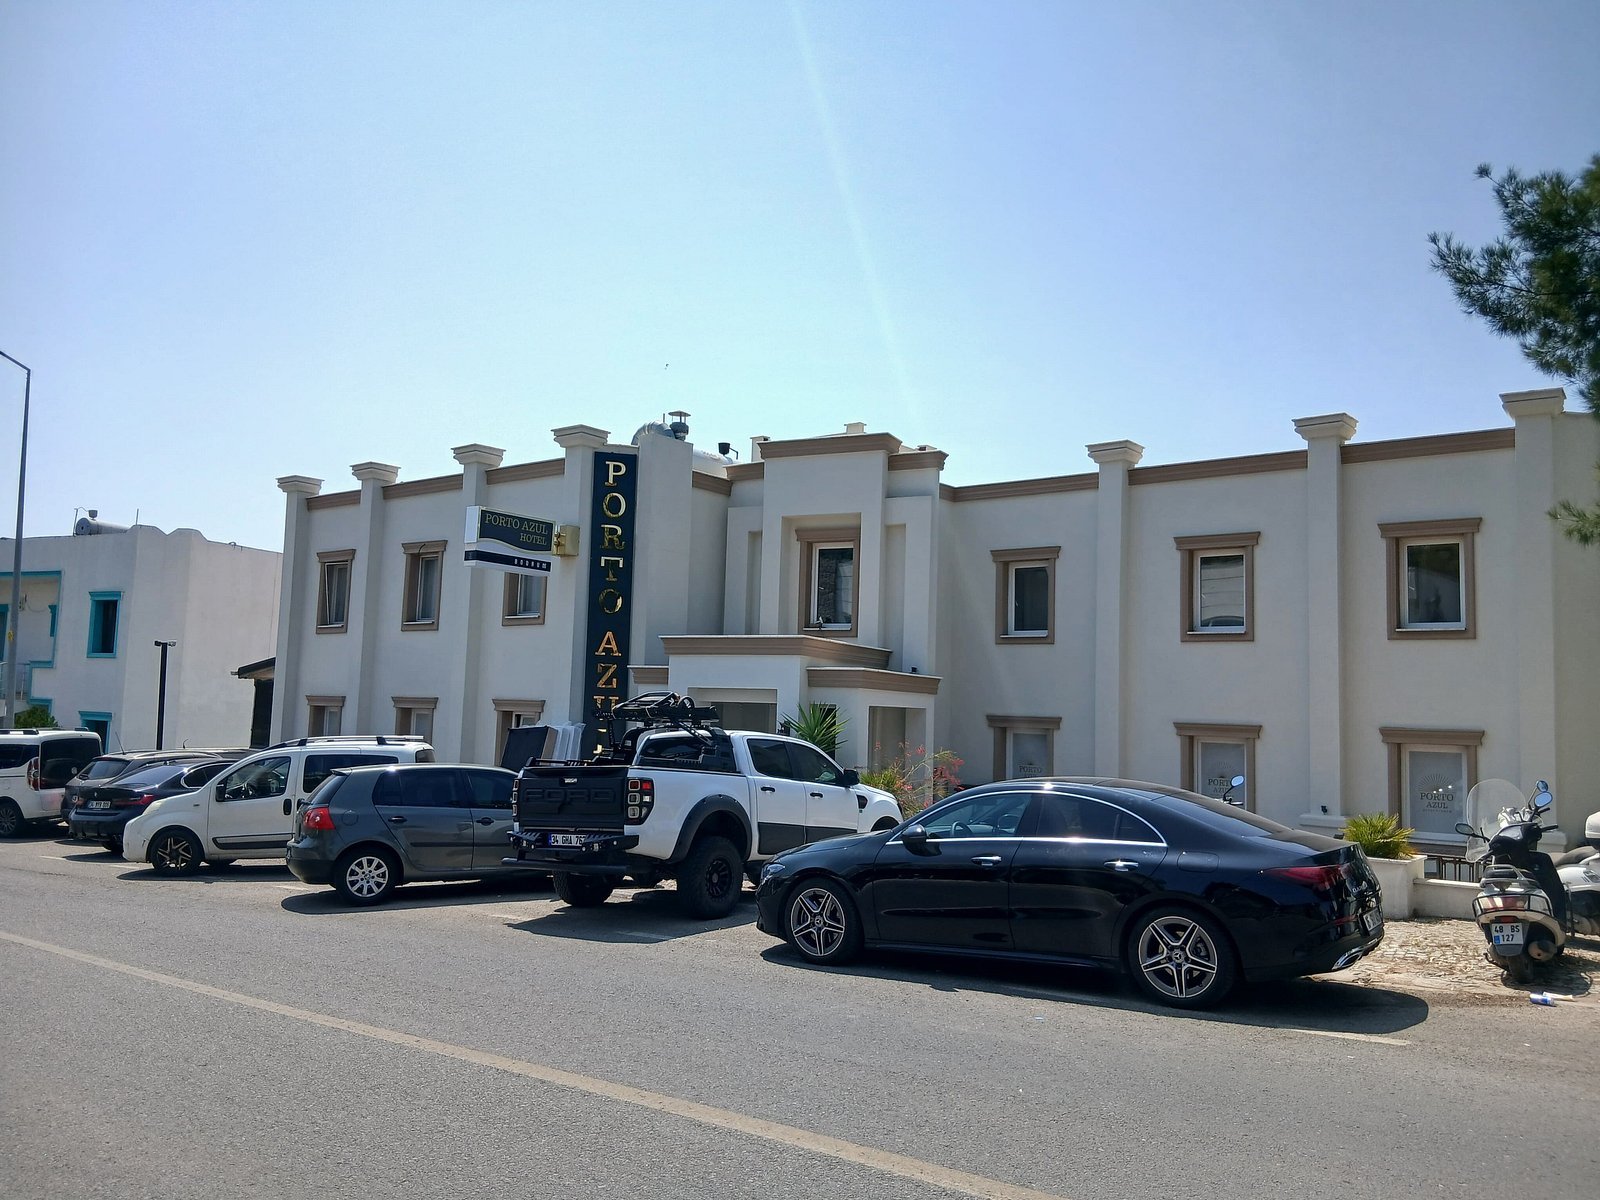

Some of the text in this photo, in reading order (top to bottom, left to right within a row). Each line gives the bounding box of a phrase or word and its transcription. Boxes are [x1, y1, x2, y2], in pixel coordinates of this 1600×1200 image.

[485, 513, 548, 534] PORTO AZUL
[520, 532, 547, 546] HOTEL
[599, 461, 627, 614] PORTO
[1018, 765, 1042, 774] PORTO
[1208, 778, 1231, 787] PORT
[524, 788, 617, 805] FORD
[1420, 792, 1454, 802] PORTO
[1426, 801, 1449, 809] AZUL
[551, 834, 559, 845] 34
[561, 835, 573, 845] GHA
[1494, 924, 1520, 933] 48 BS
[1501, 933, 1515, 942] 127
